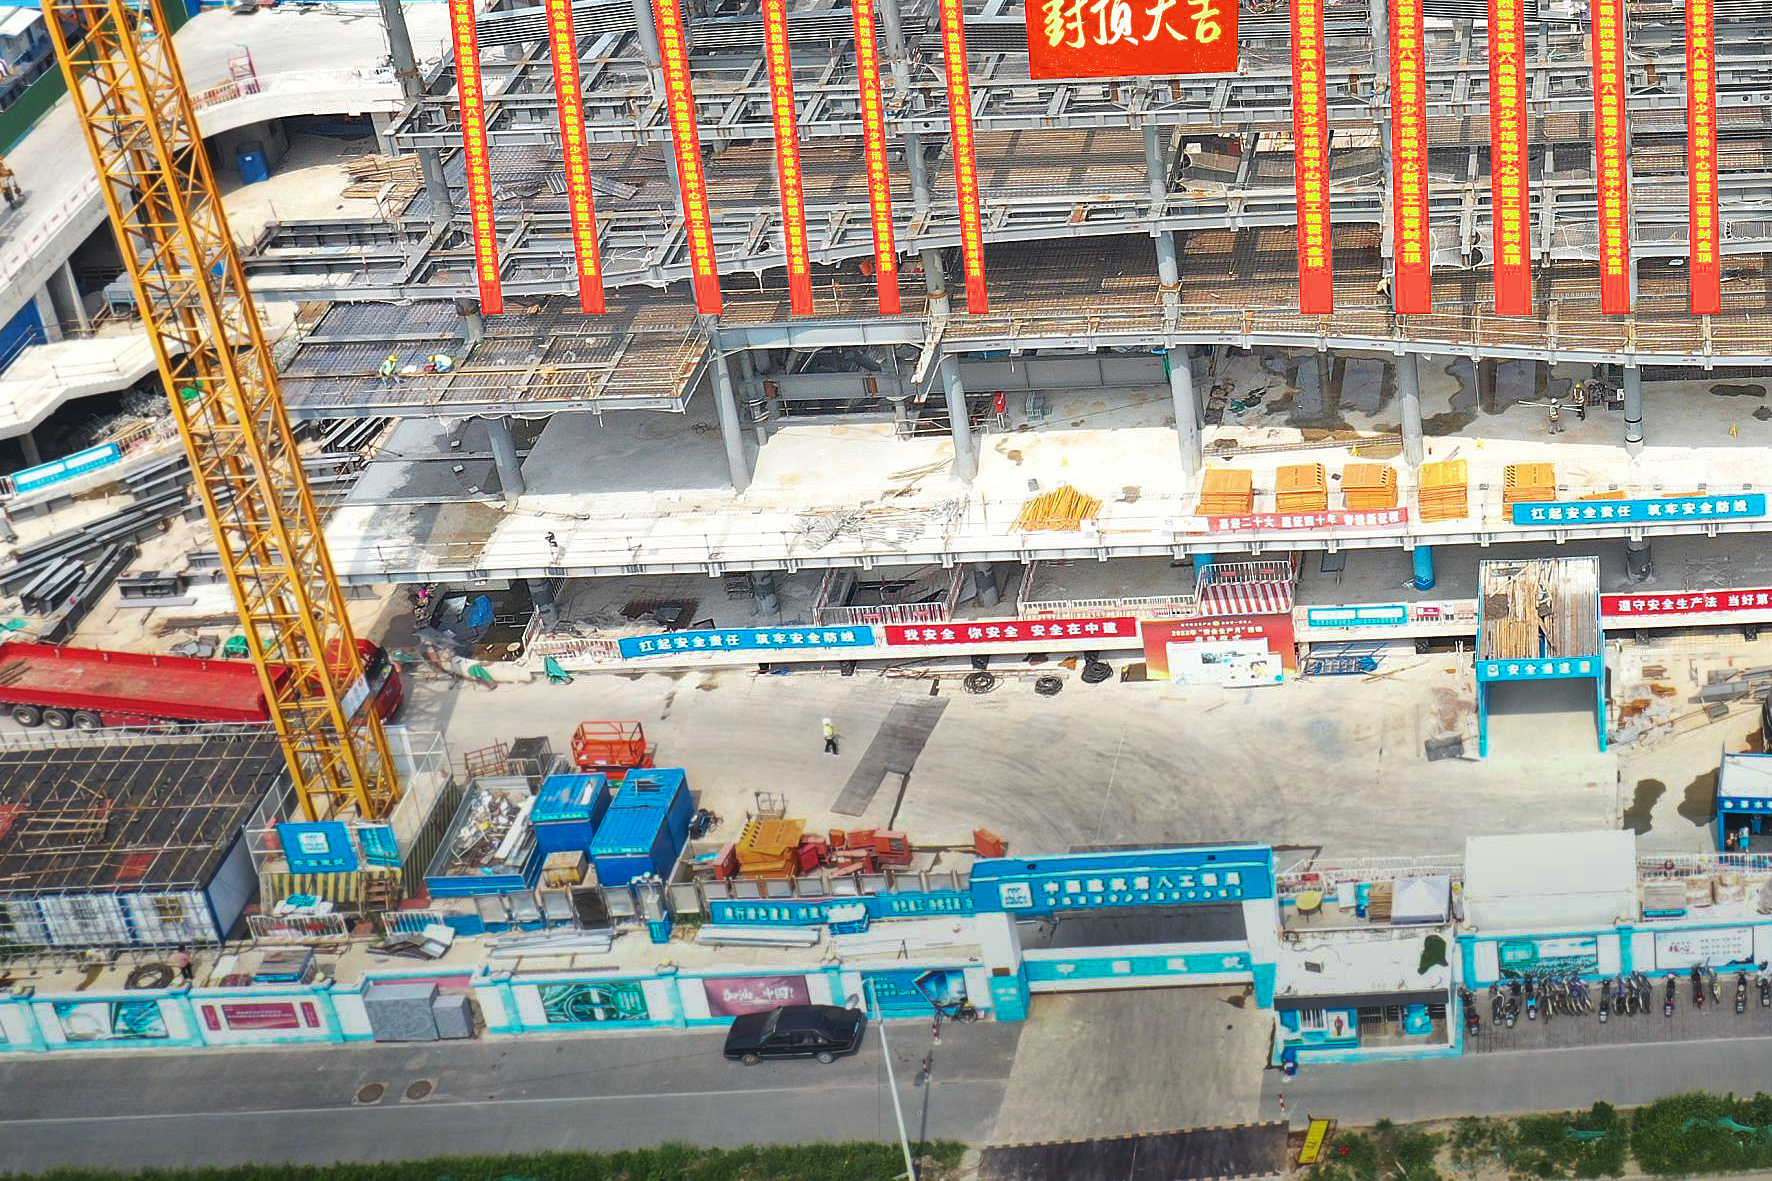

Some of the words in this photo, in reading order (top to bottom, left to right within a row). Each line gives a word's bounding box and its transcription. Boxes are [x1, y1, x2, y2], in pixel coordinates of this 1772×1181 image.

[1530, 505, 1632, 520] 扛起安全责任
[1648, 500, 1748, 515] 筑牢安全防线
[1618, 595, 1718, 612] 遵守安全生产法
[639, 634, 740, 652] 扛起安全责任
[755, 630, 856, 644] 筑牢安全防线
[904, 628, 956, 641] 我安全
[967, 626, 1020, 639] 你安全
[1031, 622, 1119, 637] 安全在中建
